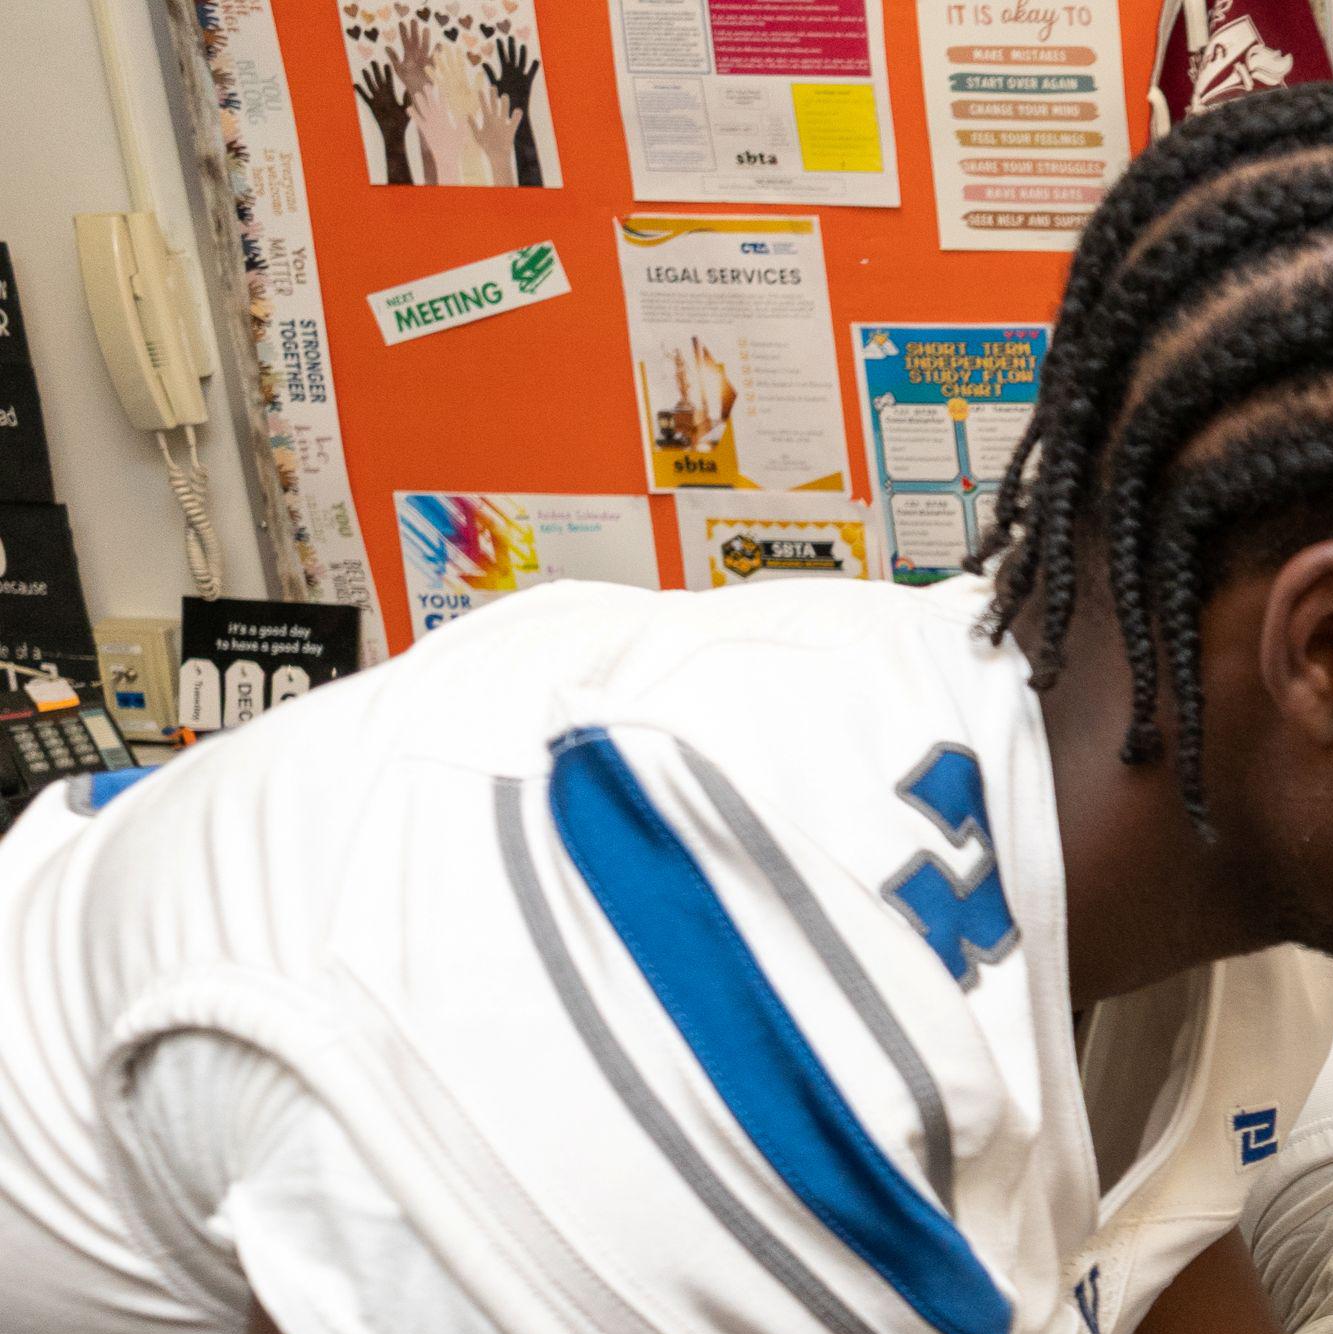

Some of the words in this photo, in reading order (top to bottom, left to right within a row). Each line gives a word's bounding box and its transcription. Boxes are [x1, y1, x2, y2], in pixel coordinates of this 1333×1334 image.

[947, 5, 966, 26] IT
[974, 4, 993, 26] IS
[1002, 0, 1059, 42] okay
[1064, 5, 1092, 26] TO
[966, 76, 1003, 89] START
[1007, 77, 1038, 90] OVER
[1041, 78, 1078, 90] AGAIN
[969, 103, 1013, 115] CHANGE
[1019, 104, 1048, 115] YOUR
[1051, 104, 1080, 116] MIND
[972, 132, 997, 143] FEEL
[1003, 132, 1031, 144] YOUR
[1035, 132, 1085, 145] FEELINGS
[736, 151, 778, 166] sbta
[1003, 162, 1033, 173] YOUR
[998, 214, 1025, 226] HELP
[1028, 215, 1050, 226] AND
[269, 238, 294, 296] MATTER
[646, 267, 700, 284] LEGAL
[707, 267, 802, 285] SERVICES
[394, 282, 503, 333] MEETING
[905, 342, 967, 356] SHORT
[983, 342, 1031, 356] TERM
[279, 319, 306, 402] TOGETHER
[300, 319, 327, 403] STRONGER
[905, 356, 1036, 370] INDEPENDENT
[909, 369, 971, 384] STUDY
[982, 369, 1034, 384] FLOW
[941, 383, 1003, 397] CHART
[674, 455, 718, 474] sbta
[771, 541, 818, 558] SBTA
[419, 594, 472, 609] YOUR
[228, 622, 247, 635] it's
[259, 624, 287, 639] good
[290, 624, 312, 640] day
[216, 638, 230, 650] to
[231, 638, 259, 651] have
[271, 640, 300, 656] good
[302, 641, 324, 657] day
